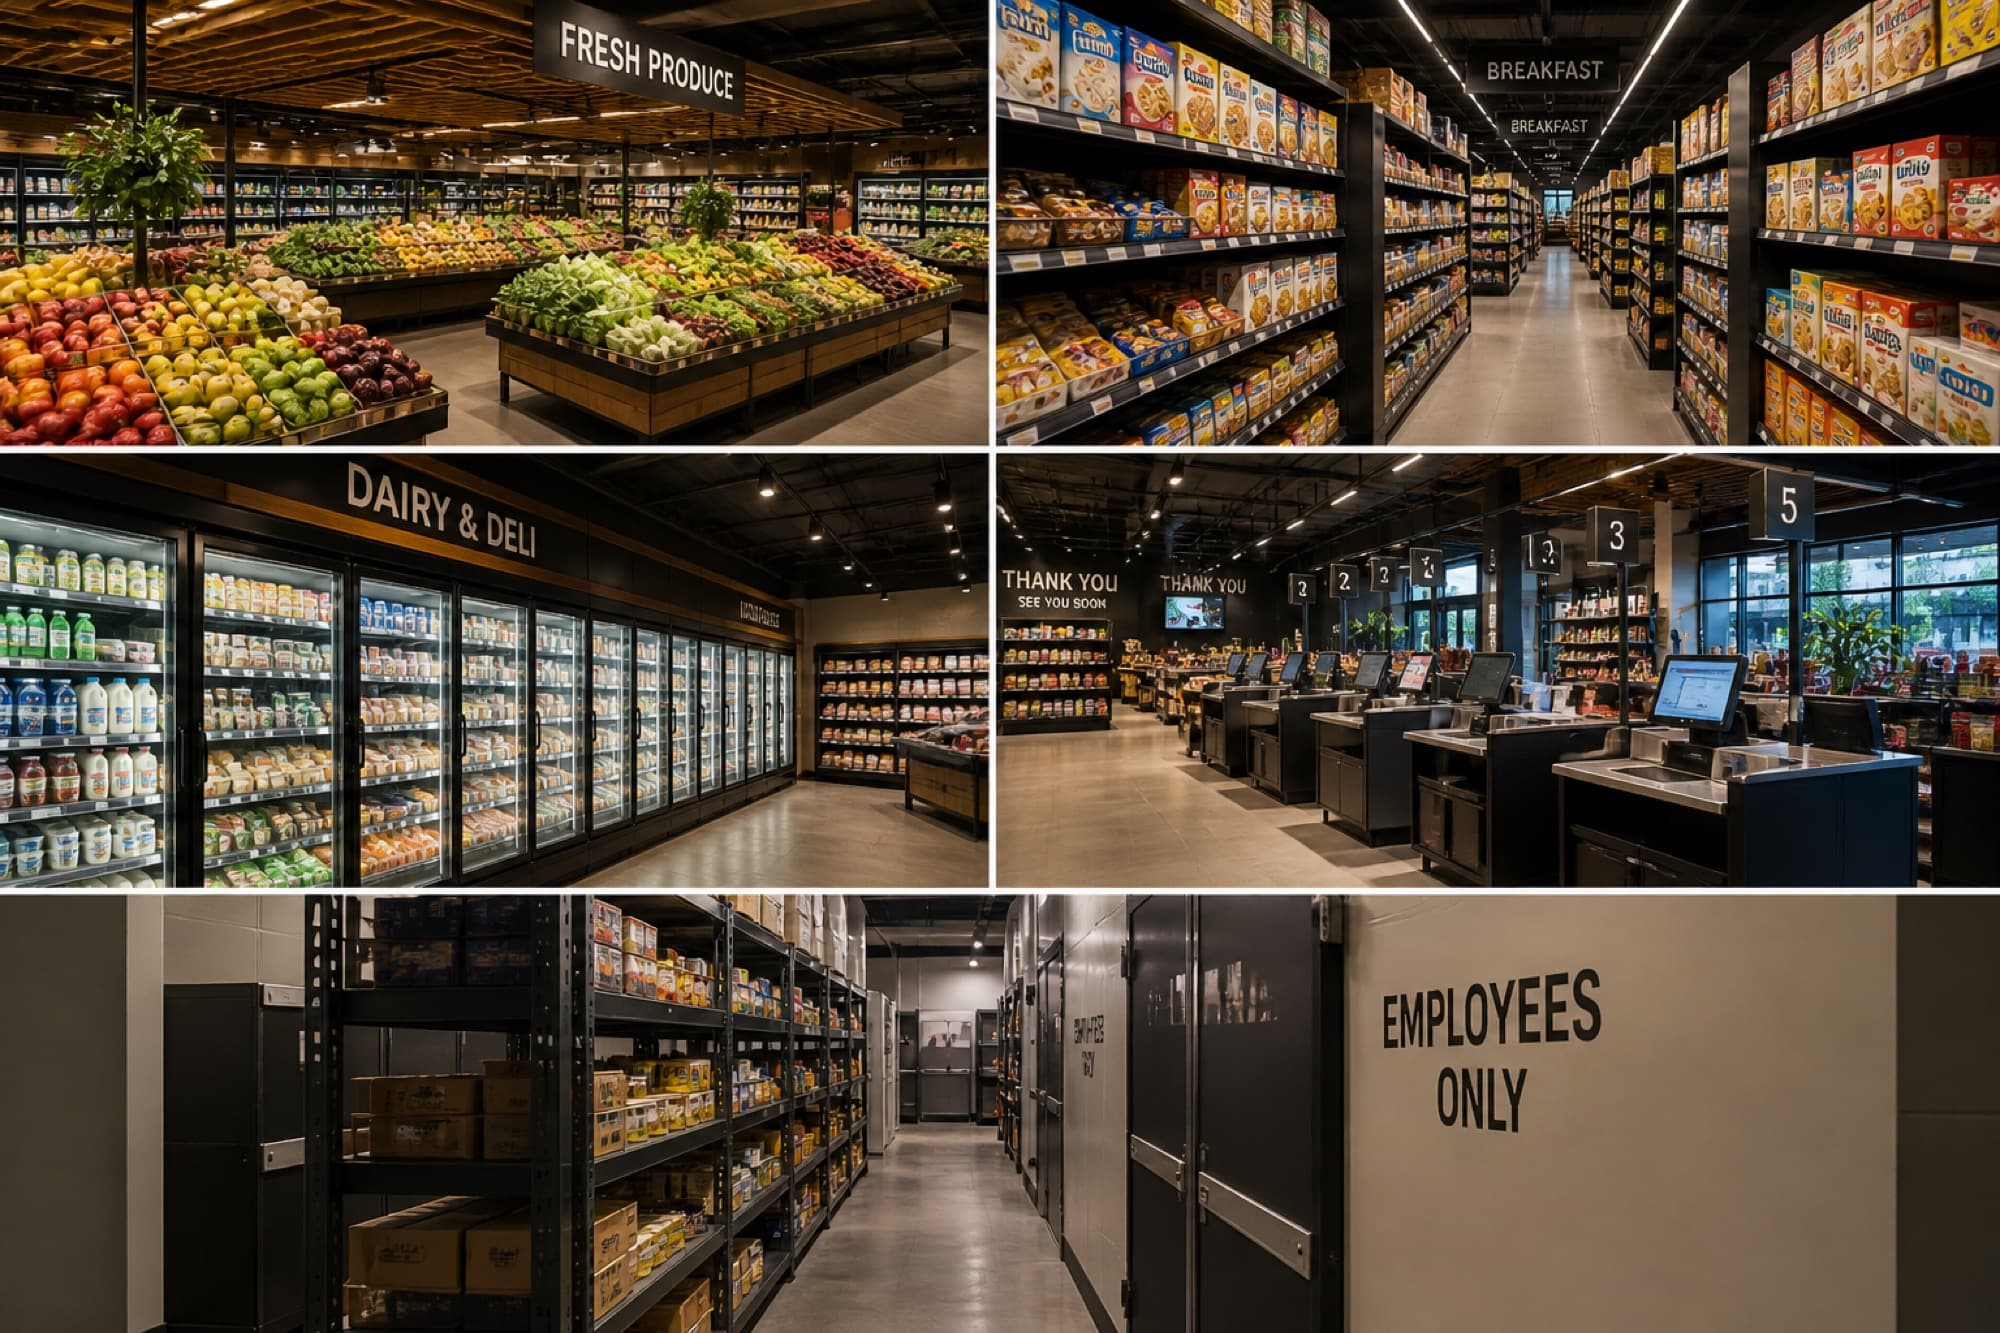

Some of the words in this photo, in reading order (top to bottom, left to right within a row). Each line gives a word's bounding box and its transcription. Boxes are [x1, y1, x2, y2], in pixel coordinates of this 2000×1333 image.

[561, 20, 640, 76] FRESH
[649, 47, 734, 101] PRODUCE
[1487, 60, 1604, 80] BREAKFAST
[1511, 119, 1588, 134] BREAKFAST
[347, 461, 451, 532] DAIRY
[458, 502, 479, 541] &
[487, 511, 536, 559] DELI
[1780, 486, 1798, 524] 5
[1609, 520, 1625, 550] 3
[1002, 569, 1073, 592] THANK
[1078, 573, 1118, 593] YOU
[1216, 578, 1247, 595] YOU
[1338, 572, 1351, 590] 2
[1018, 595, 1041, 609] SEE
[1044, 596, 1070, 609] YOU
[1073, 597, 1107, 610] SOON
[1383, 968, 1602, 1048] EMPLOYEES
[1437, 1066, 1528, 1133] ONLY
